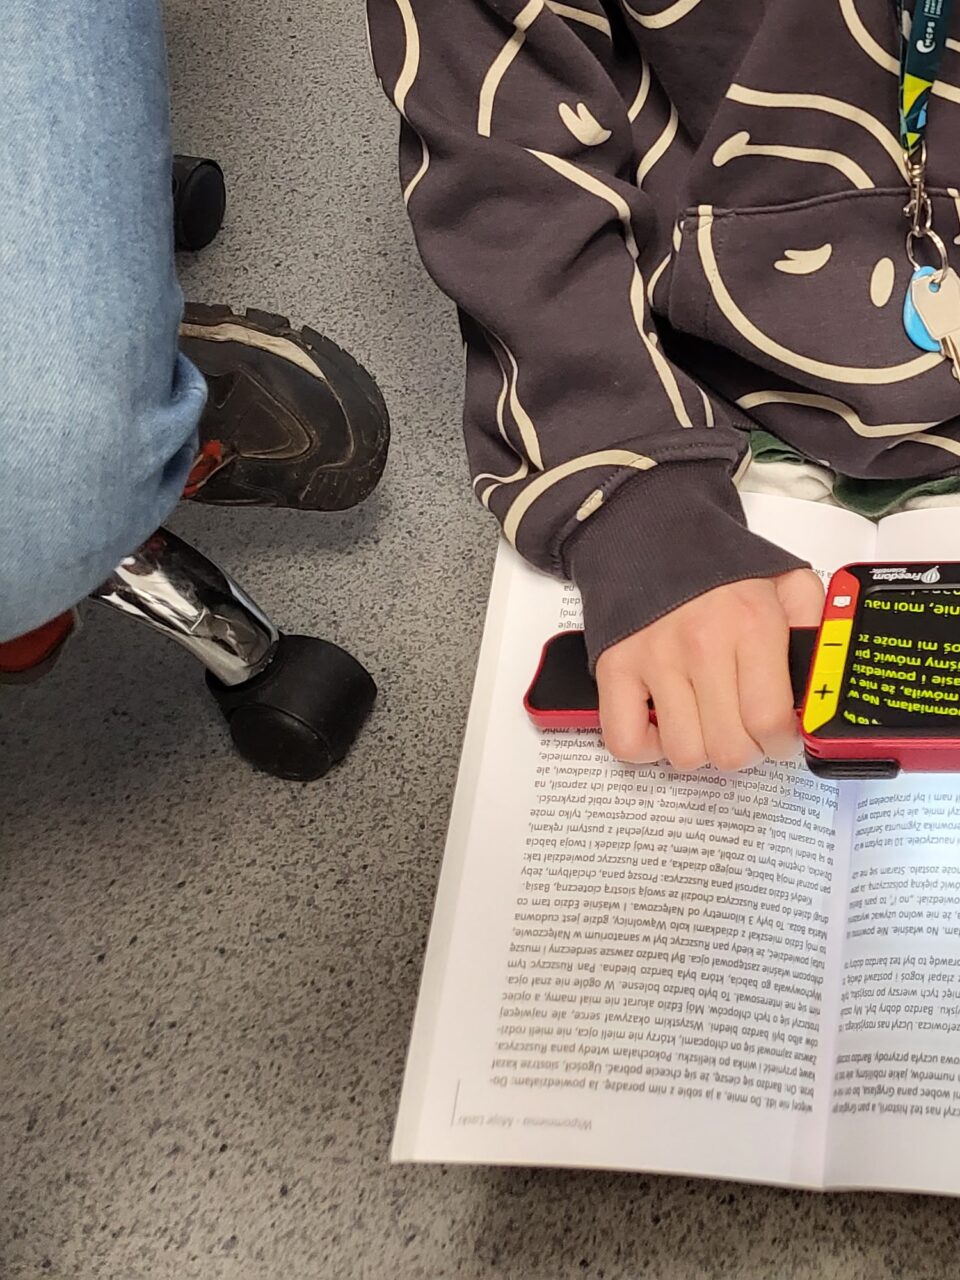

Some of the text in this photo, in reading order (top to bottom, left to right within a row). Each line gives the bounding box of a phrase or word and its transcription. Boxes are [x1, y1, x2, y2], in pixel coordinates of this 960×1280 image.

[873, 573, 922, 581] Freedom
[560, 608, 577, 618] mój
[894, 602, 925, 614] moi
[873, 636, 912, 650] może
[918, 641, 938, 651] mi
[873, 652, 921, 666] mówić
[859, 679, 878, 689] nie
[921, 675, 926, 684] i
[881, 684, 895, 694] że
[900, 685, 959, 701] mówiła,
[862, 693, 879, 705] No
[554, 739, 594, 748] wstydzić,
[539, 752, 608, 763] nie rozumiecie,
[526, 838, 557, 850] babcia
[558, 837, 587, 851] twoja
[594, 841, 632, 854] dziadek
[632, 840, 655, 854] twój
[668, 844, 700, 858] wiem,
[700, 849, 717, 860] ale
[716, 849, 747, 863] zrobił,
[757, 855, 777, 871] bym
[777, 860, 806, 876] chętnie
[520, 865, 813, 908] Kiedyś Edzio zaprosił pana Ruszczyca: Proszę pana, chciałbym, żeby
[514, 914, 560, 926] cudowna
[560, 913, 581, 927] jest
[582, 914, 610, 928] gdzie
[610, 915, 667, 932] Wąwolnicy,
[691, 924, 740, 941] dziadkami
[747, 932, 784, 947] mieszkał
[509, 942, 542, 954] muszę
[547, 943, 598, 959] serdeczny
[784, 938, 804, 952] Edzio
[804, 939, 820, 954] mój
[599, 949, 636, 958] zawsze
[635, 951, 670, 964] bardzo
[670, 951, 686, 966] Był
[687, 954, 711, 968] ojca.
[711, 958, 761, 973] zastępował
[761, 965, 791, 980] właśnie
[792, 971, 824, 988] chłopcom
[499, 1006, 819, 1051] ców albo byli bardzo biedni. Wszystkim okazywał serce, ale najwięcej
[873, 1051, 910, 1065] przyrody.
[910, 1053, 939, 1067] uczyła
